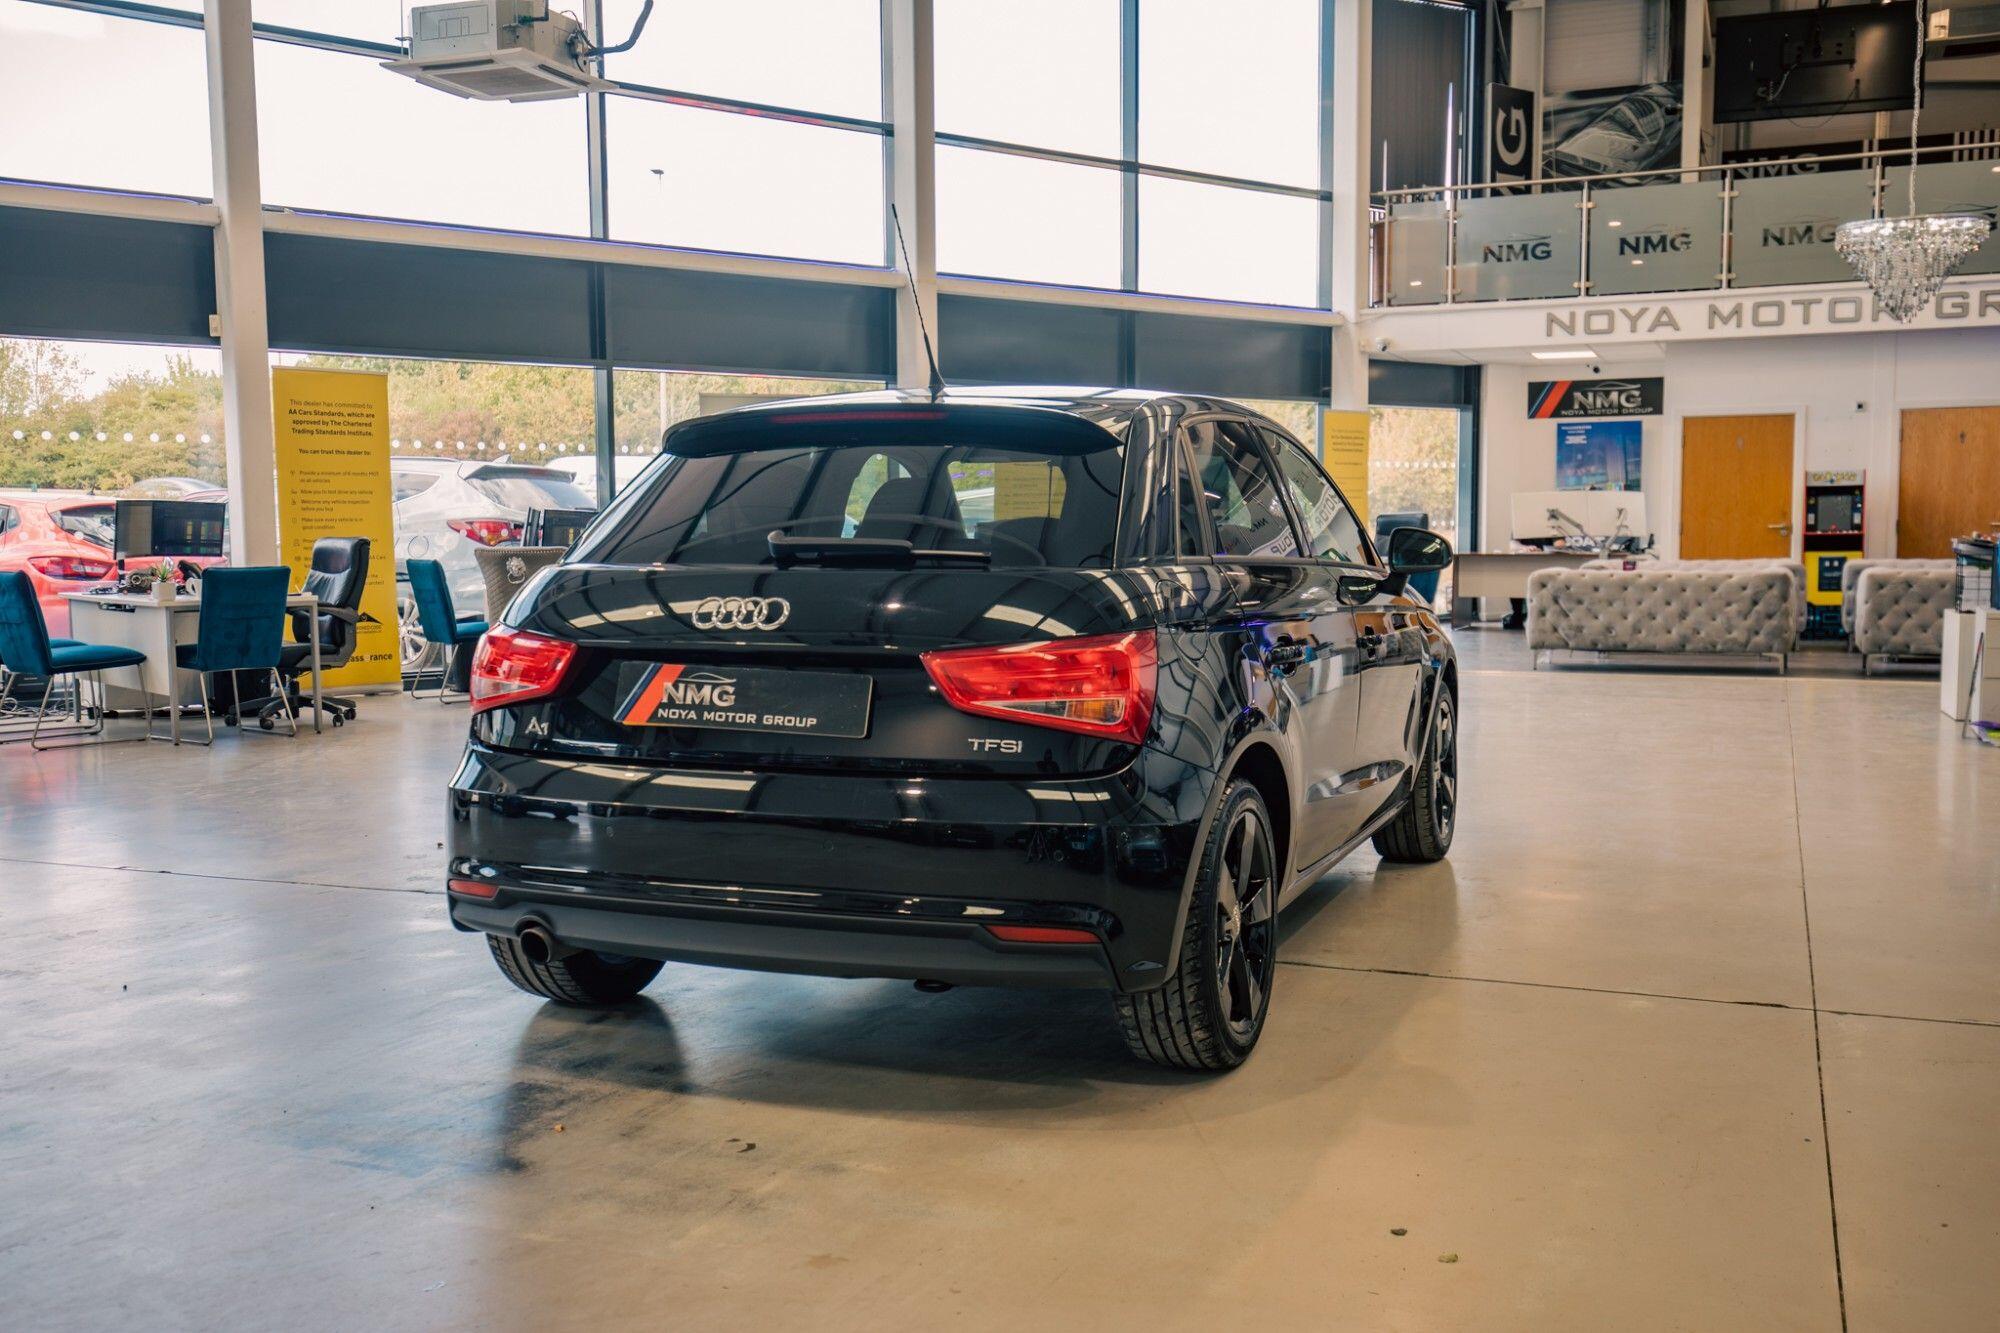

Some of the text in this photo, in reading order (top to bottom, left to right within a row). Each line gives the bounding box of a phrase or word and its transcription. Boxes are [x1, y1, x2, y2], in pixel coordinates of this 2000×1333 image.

[1482, 242, 1552, 263] NMG
[1619, 233, 1692, 256] NMG
[1546, 305, 1680, 337] NOYA
[1573, 389, 1642, 409] NMG
[292, 419, 321, 427] approved
[661, 681, 736, 707] NMG
[525, 716, 549, 736] A1
[657, 708, 817, 728] NOYA MOTOR GROUP
[967, 738, 1023, 753] TFSI
